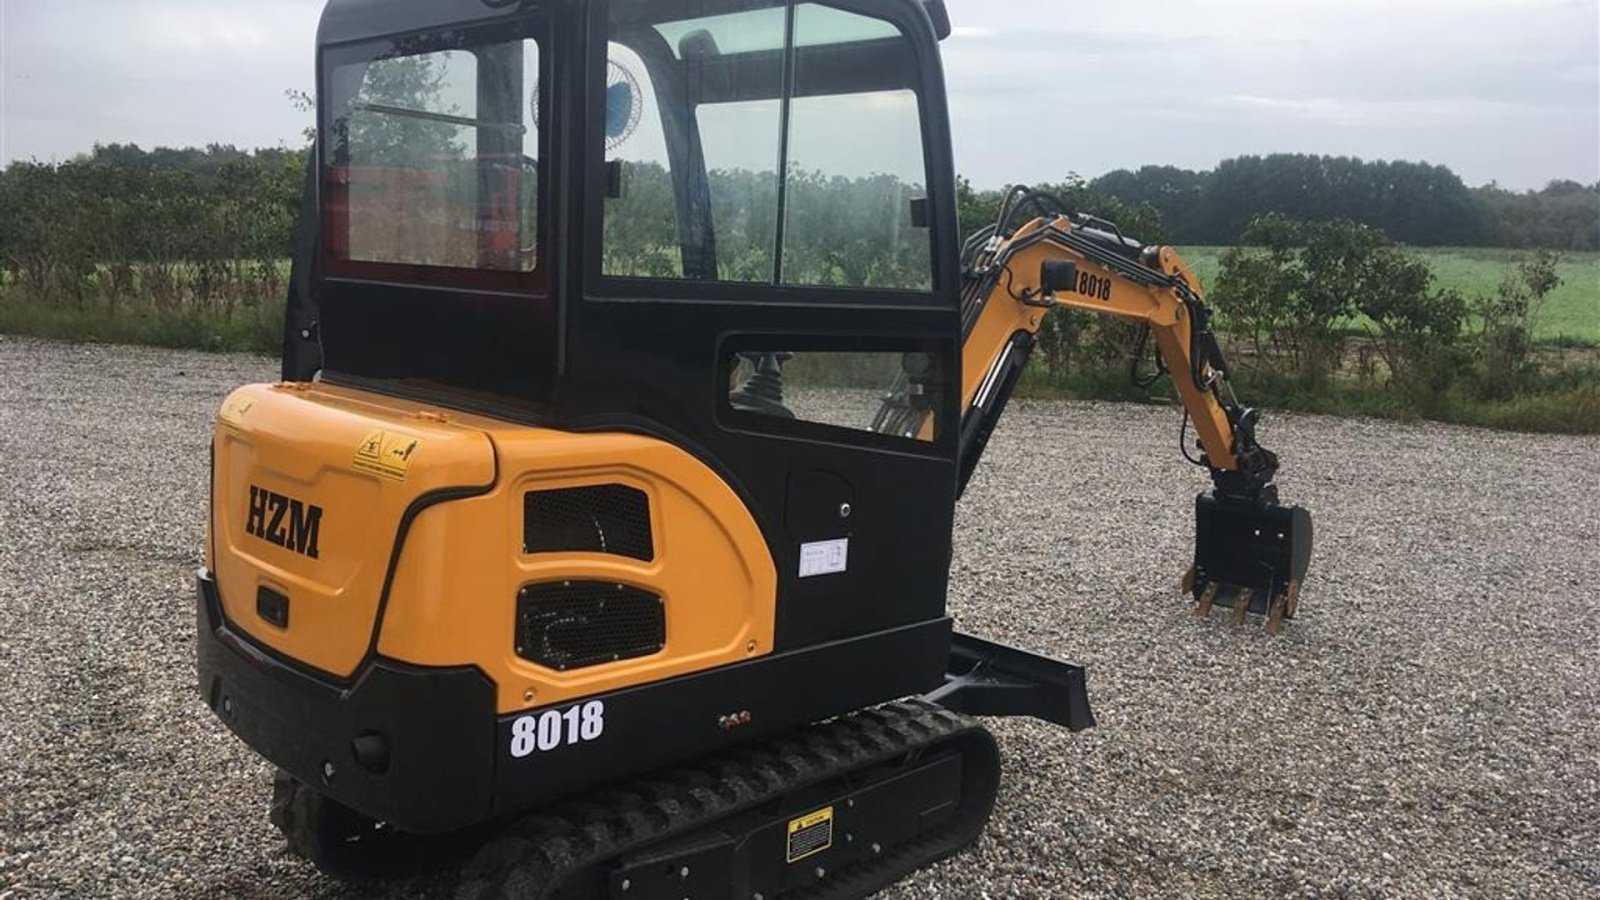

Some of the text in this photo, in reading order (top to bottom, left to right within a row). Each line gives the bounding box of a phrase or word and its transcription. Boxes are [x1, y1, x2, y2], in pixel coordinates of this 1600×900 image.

[1079, 271, 1112, 301] 8018
[245, 484, 323, 560] HZM
[510, 700, 604, 758] 8018
